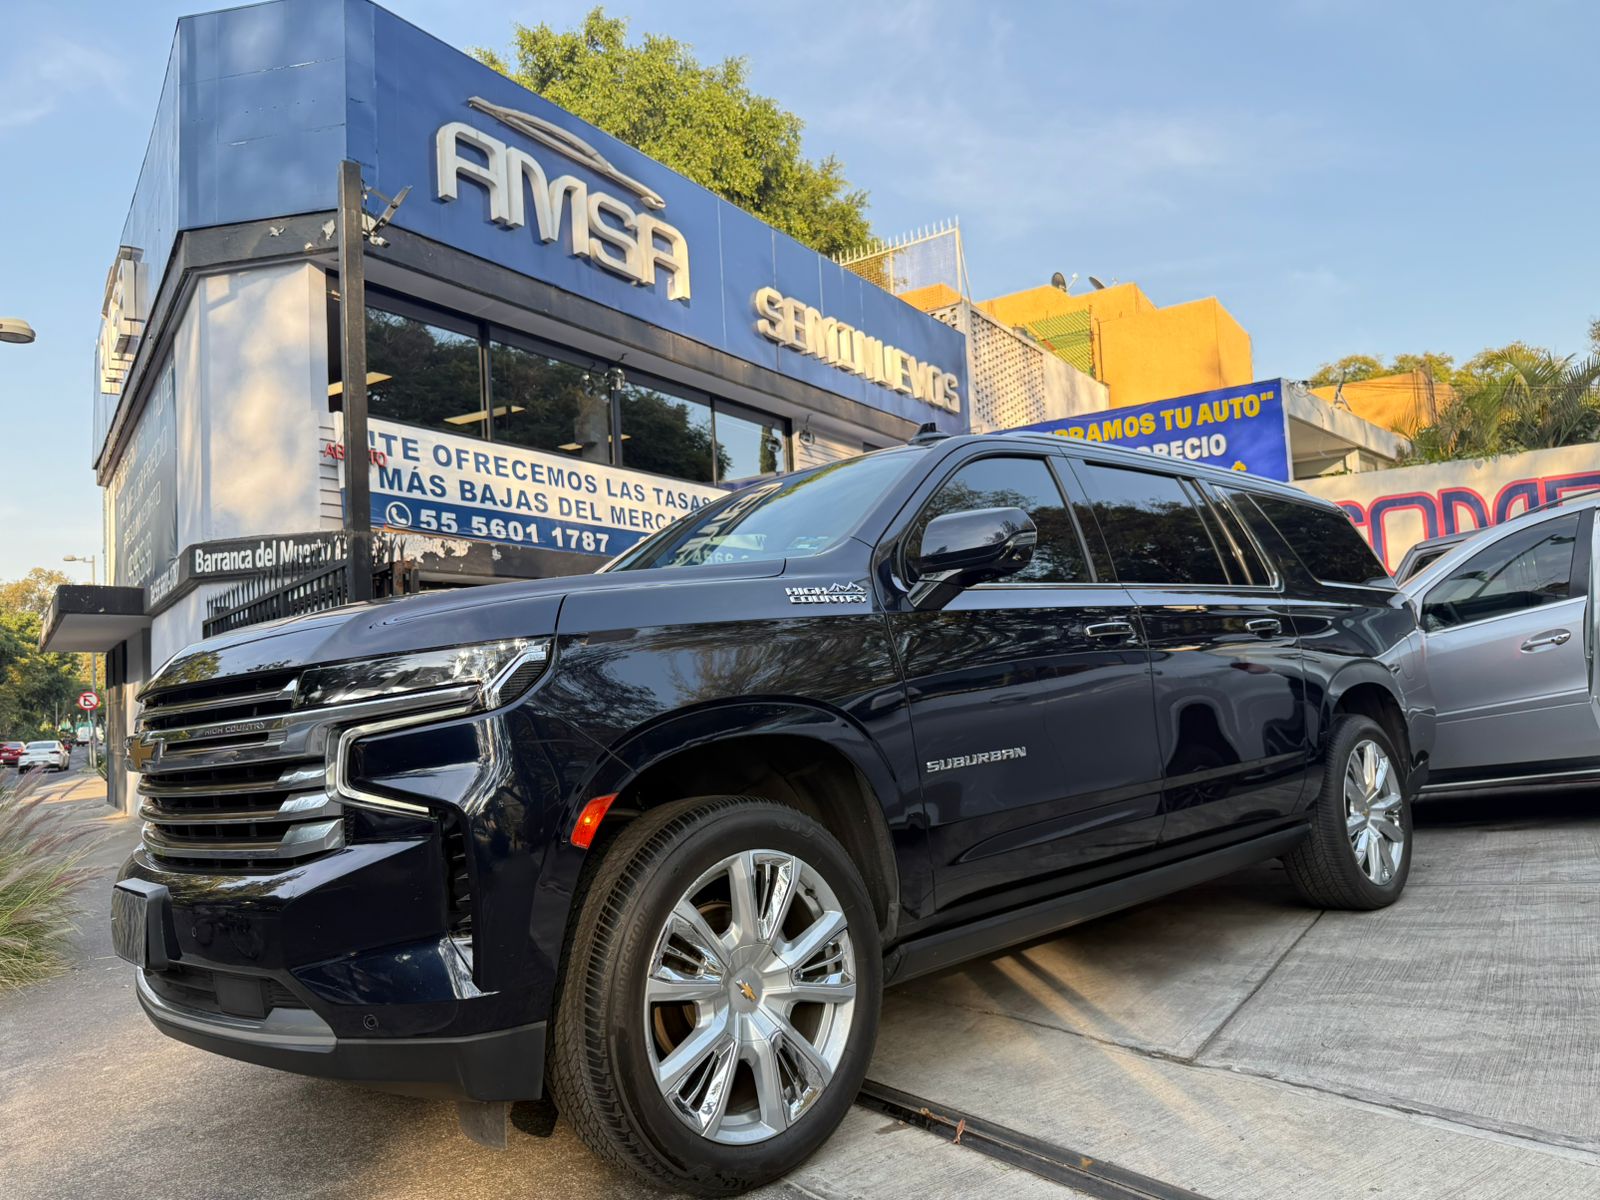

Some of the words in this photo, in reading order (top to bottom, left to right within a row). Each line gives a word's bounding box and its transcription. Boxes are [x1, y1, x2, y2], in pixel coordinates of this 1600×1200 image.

[436, 121, 691, 301] AMSA
[754, 286, 960, 414] SEMINUEVOS
[1160, 407, 1193, 432] TU
[323, 442, 388, 468] ABTO
[432, 443, 598, 495] OFRECEMOS
[606, 478, 645, 502] LAS
[378, 466, 447, 498] MÁS
[459, 479, 549, 514] BAJAS
[558, 496, 602, 522] DEL
[419, 508, 459, 534] 55
[471, 515, 540, 543] 5601
[551, 527, 610, 553] 1787
[195, 549, 252, 574] Barranca
[255, 540, 277, 568] del
[785, 587, 828, 596] HIGH
[790, 594, 867, 604] COUNTRY
[926, 746, 1027, 773] SUBURBAN
